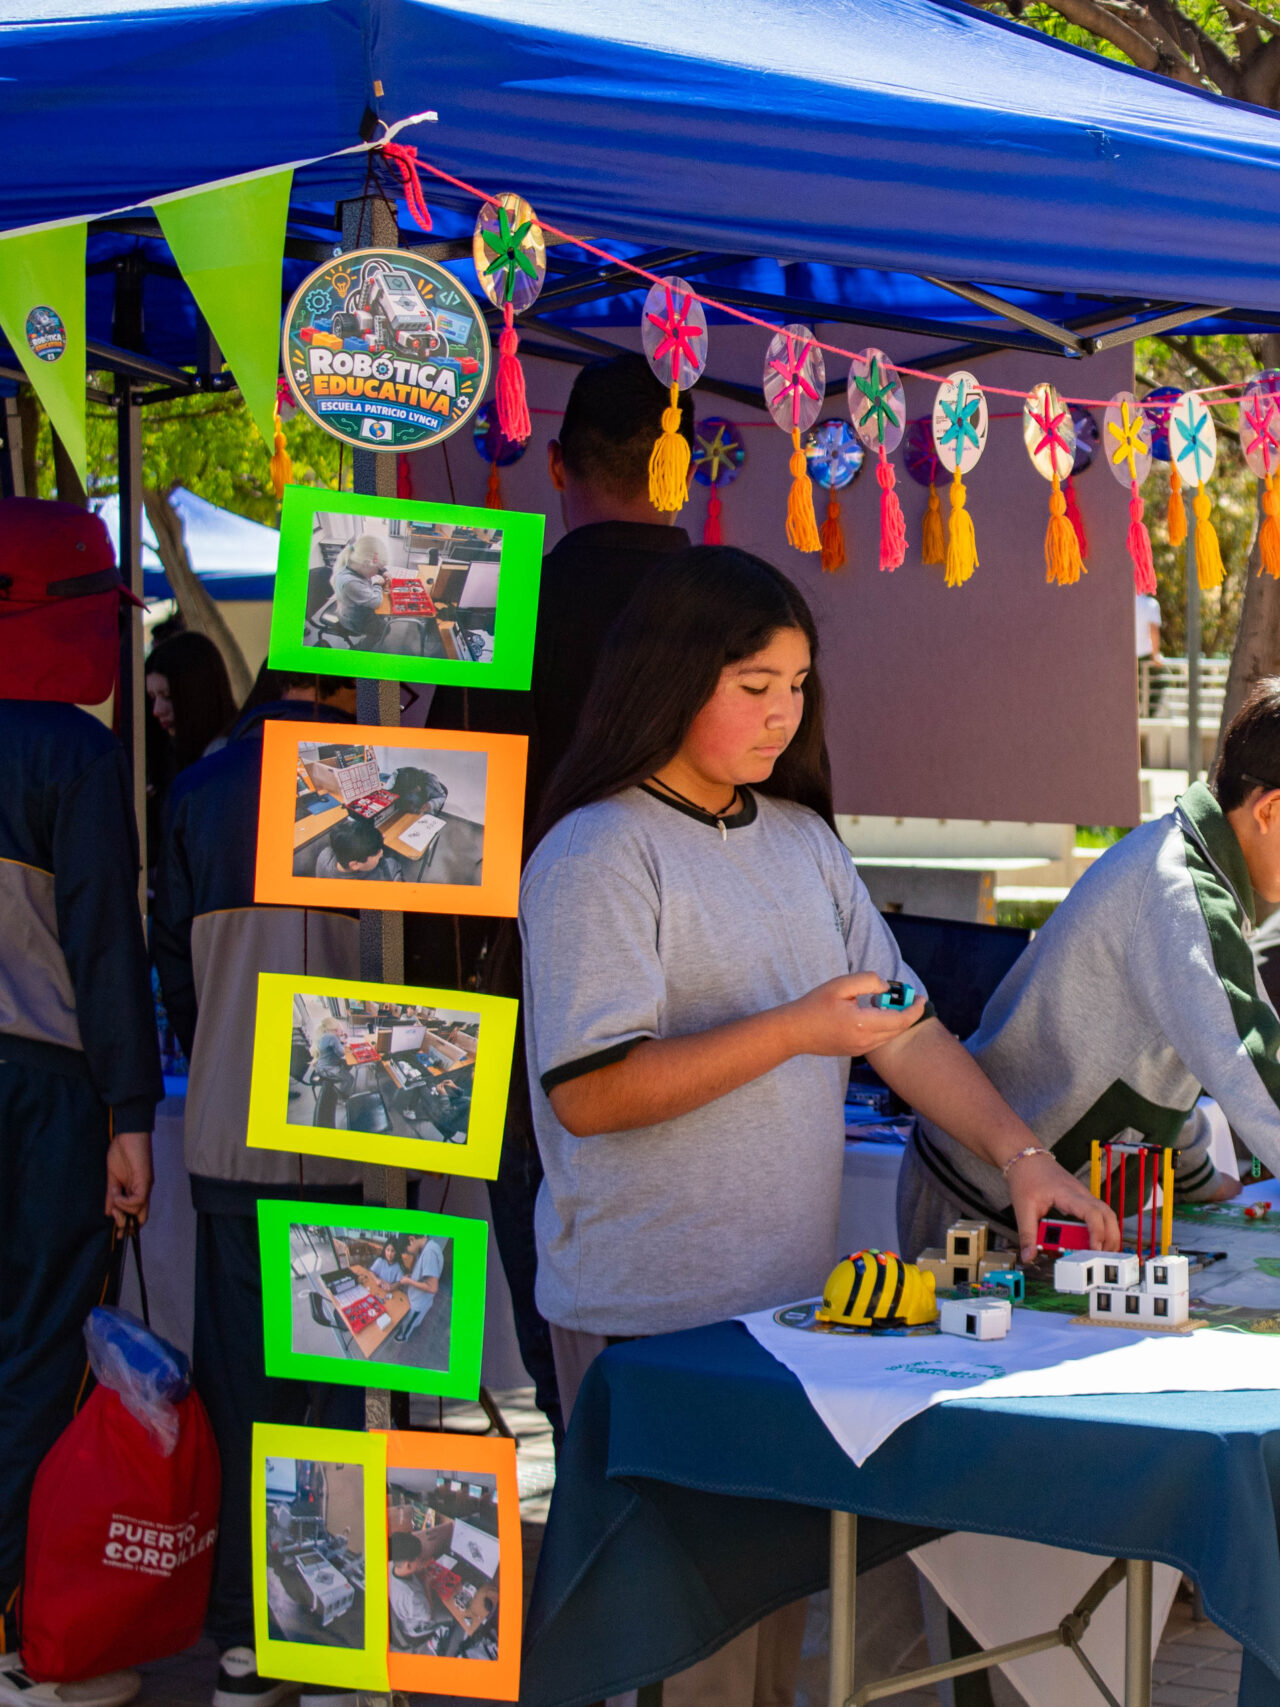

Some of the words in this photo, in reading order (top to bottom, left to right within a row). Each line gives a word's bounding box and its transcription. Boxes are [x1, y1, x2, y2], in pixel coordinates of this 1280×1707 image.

[308, 348, 457, 397] ROBÓTICA
[313, 375, 450, 416] EDUCATIVA
[320, 402, 362, 412] ESCUELA
[364, 406, 407, 418] PATRICIO
[408, 412, 438, 428] LYNCH
[105, 1528, 219, 1570] CORDILLER
[109, 1521, 196, 1550] PUERTO
